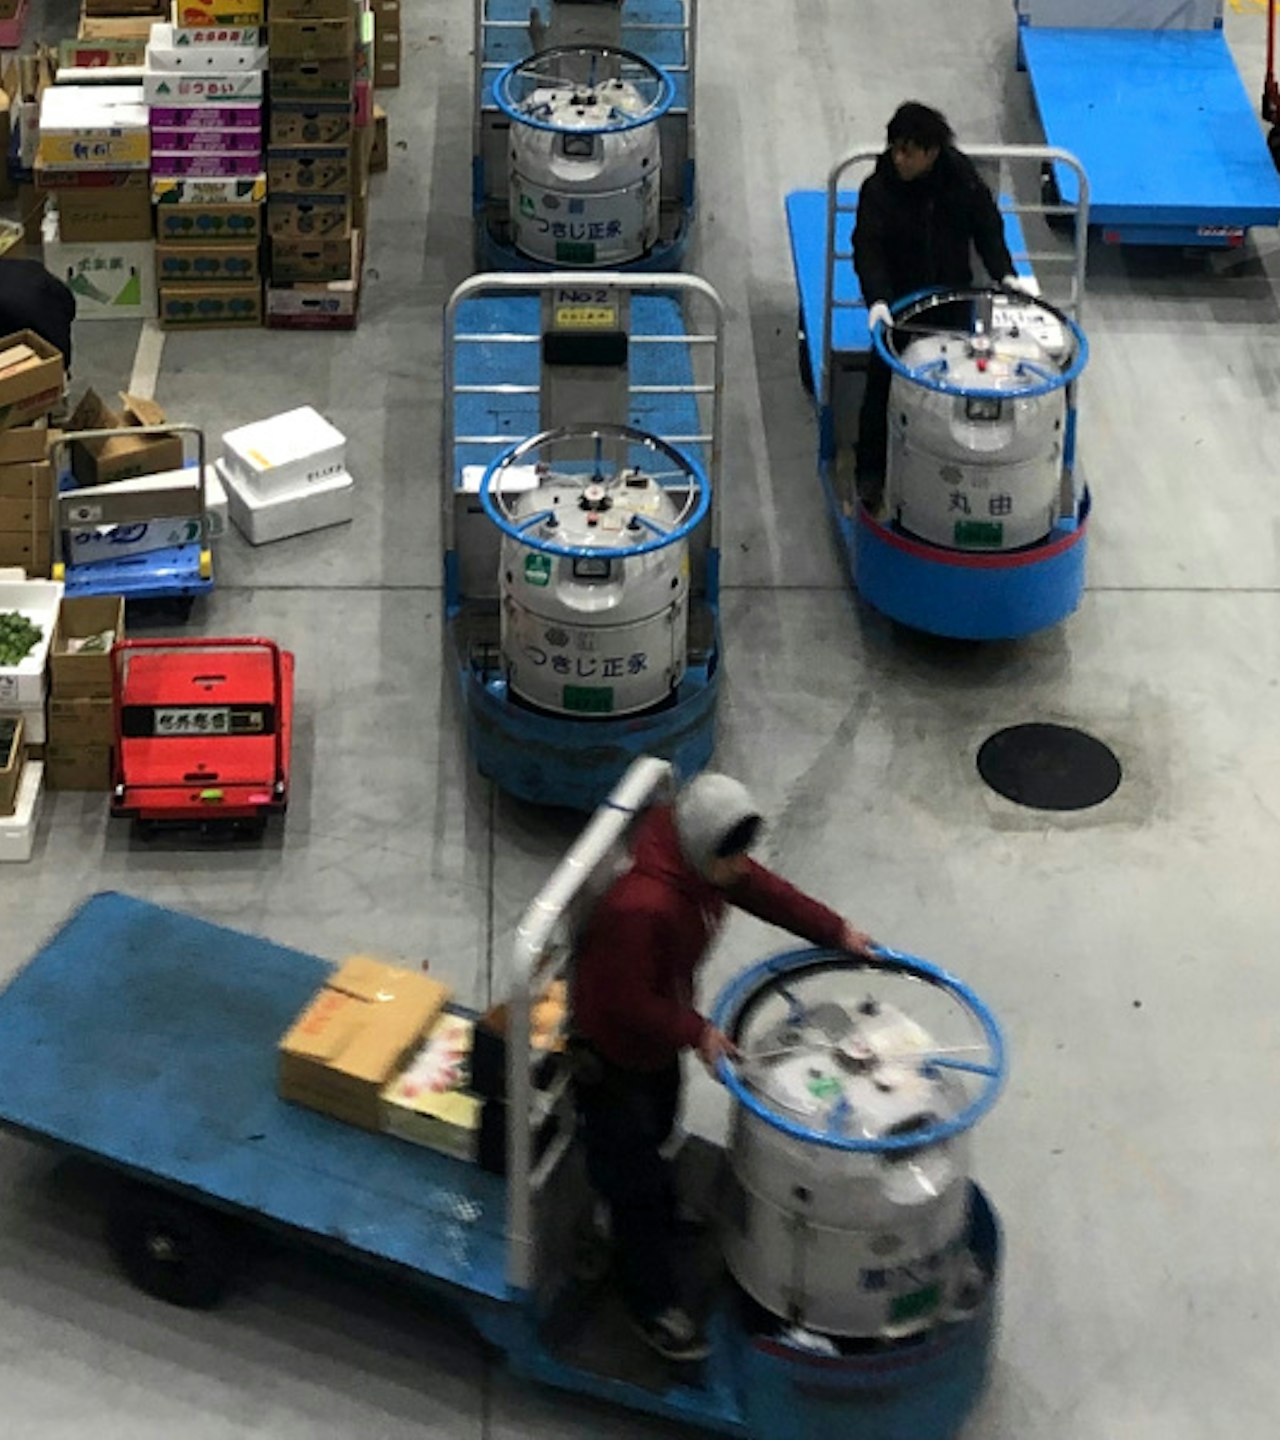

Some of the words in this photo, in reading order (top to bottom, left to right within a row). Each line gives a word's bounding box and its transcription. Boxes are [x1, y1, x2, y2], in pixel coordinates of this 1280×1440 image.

[527, 644, 649, 678] つきじ正永
